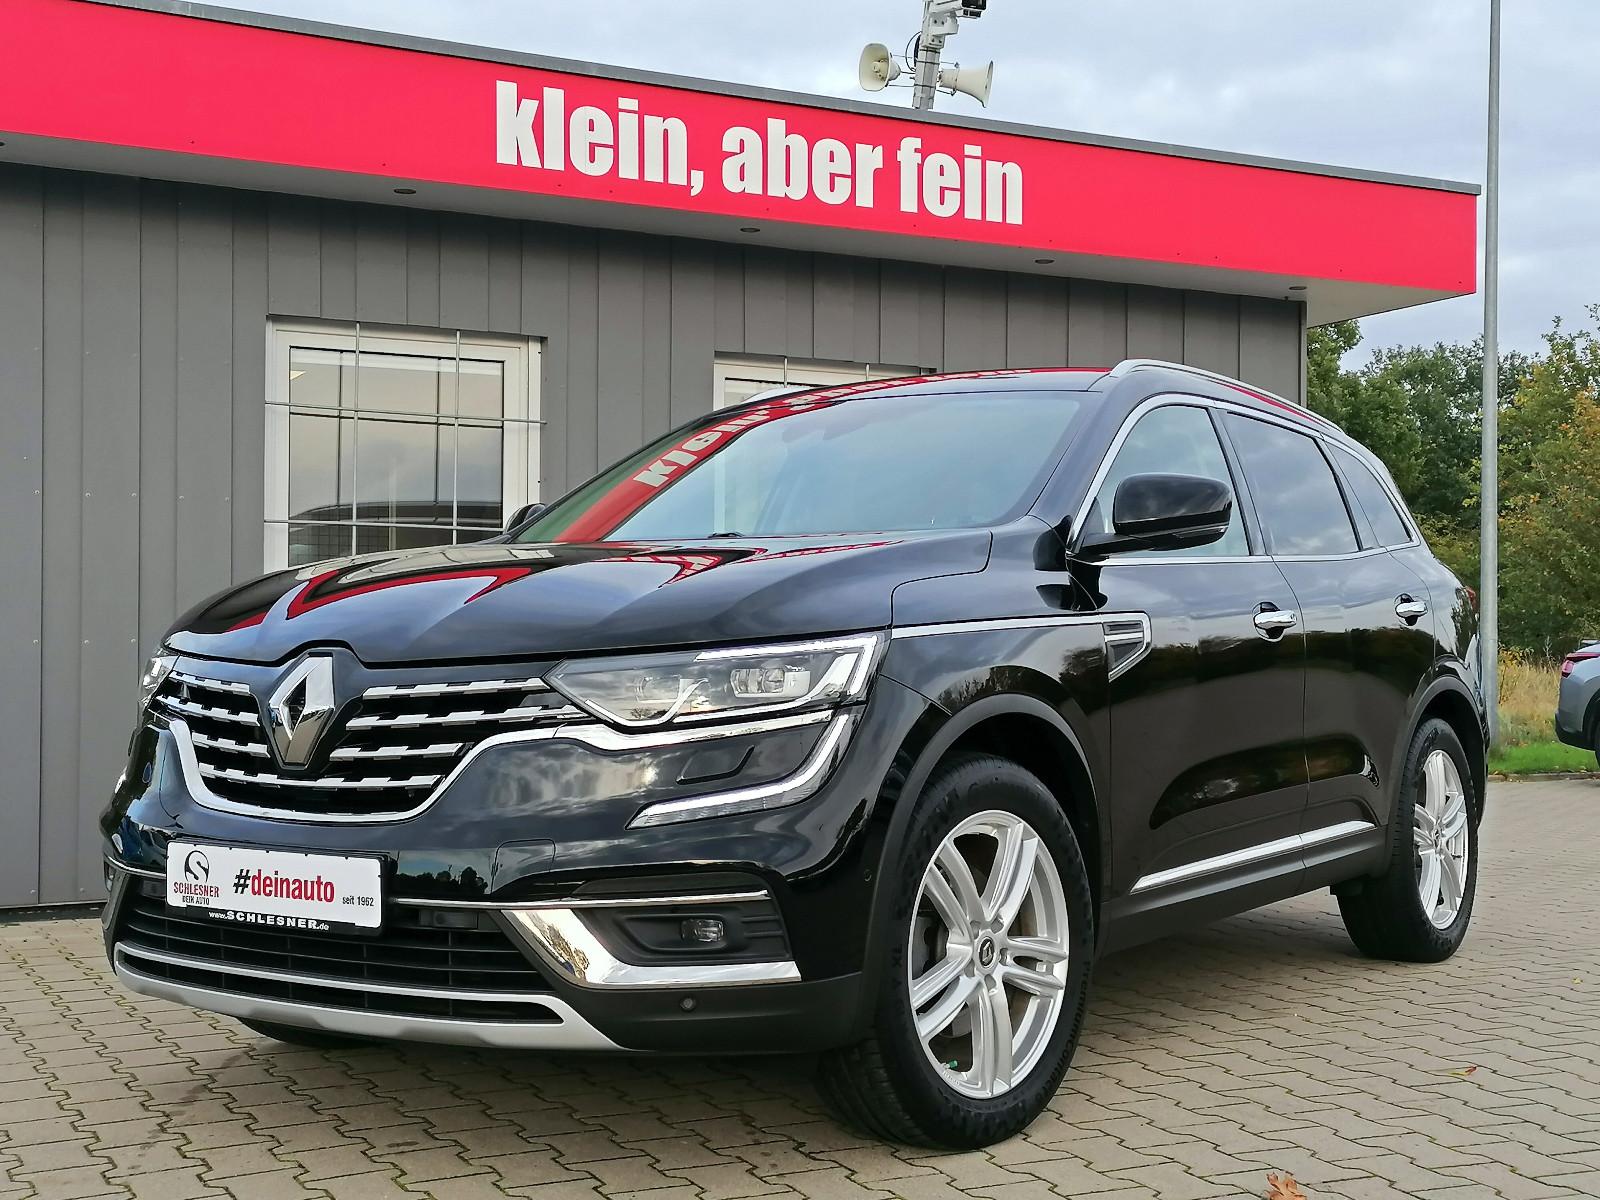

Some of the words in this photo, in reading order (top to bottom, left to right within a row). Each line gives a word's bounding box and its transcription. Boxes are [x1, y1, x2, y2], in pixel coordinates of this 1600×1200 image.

[496, 80, 704, 196] klein,
[722, 117, 884, 209] aber
[897, 137, 1023, 225] fein
[173, 882, 220, 899] SCHLESNER
[232, 868, 335, 903] #deinauto
